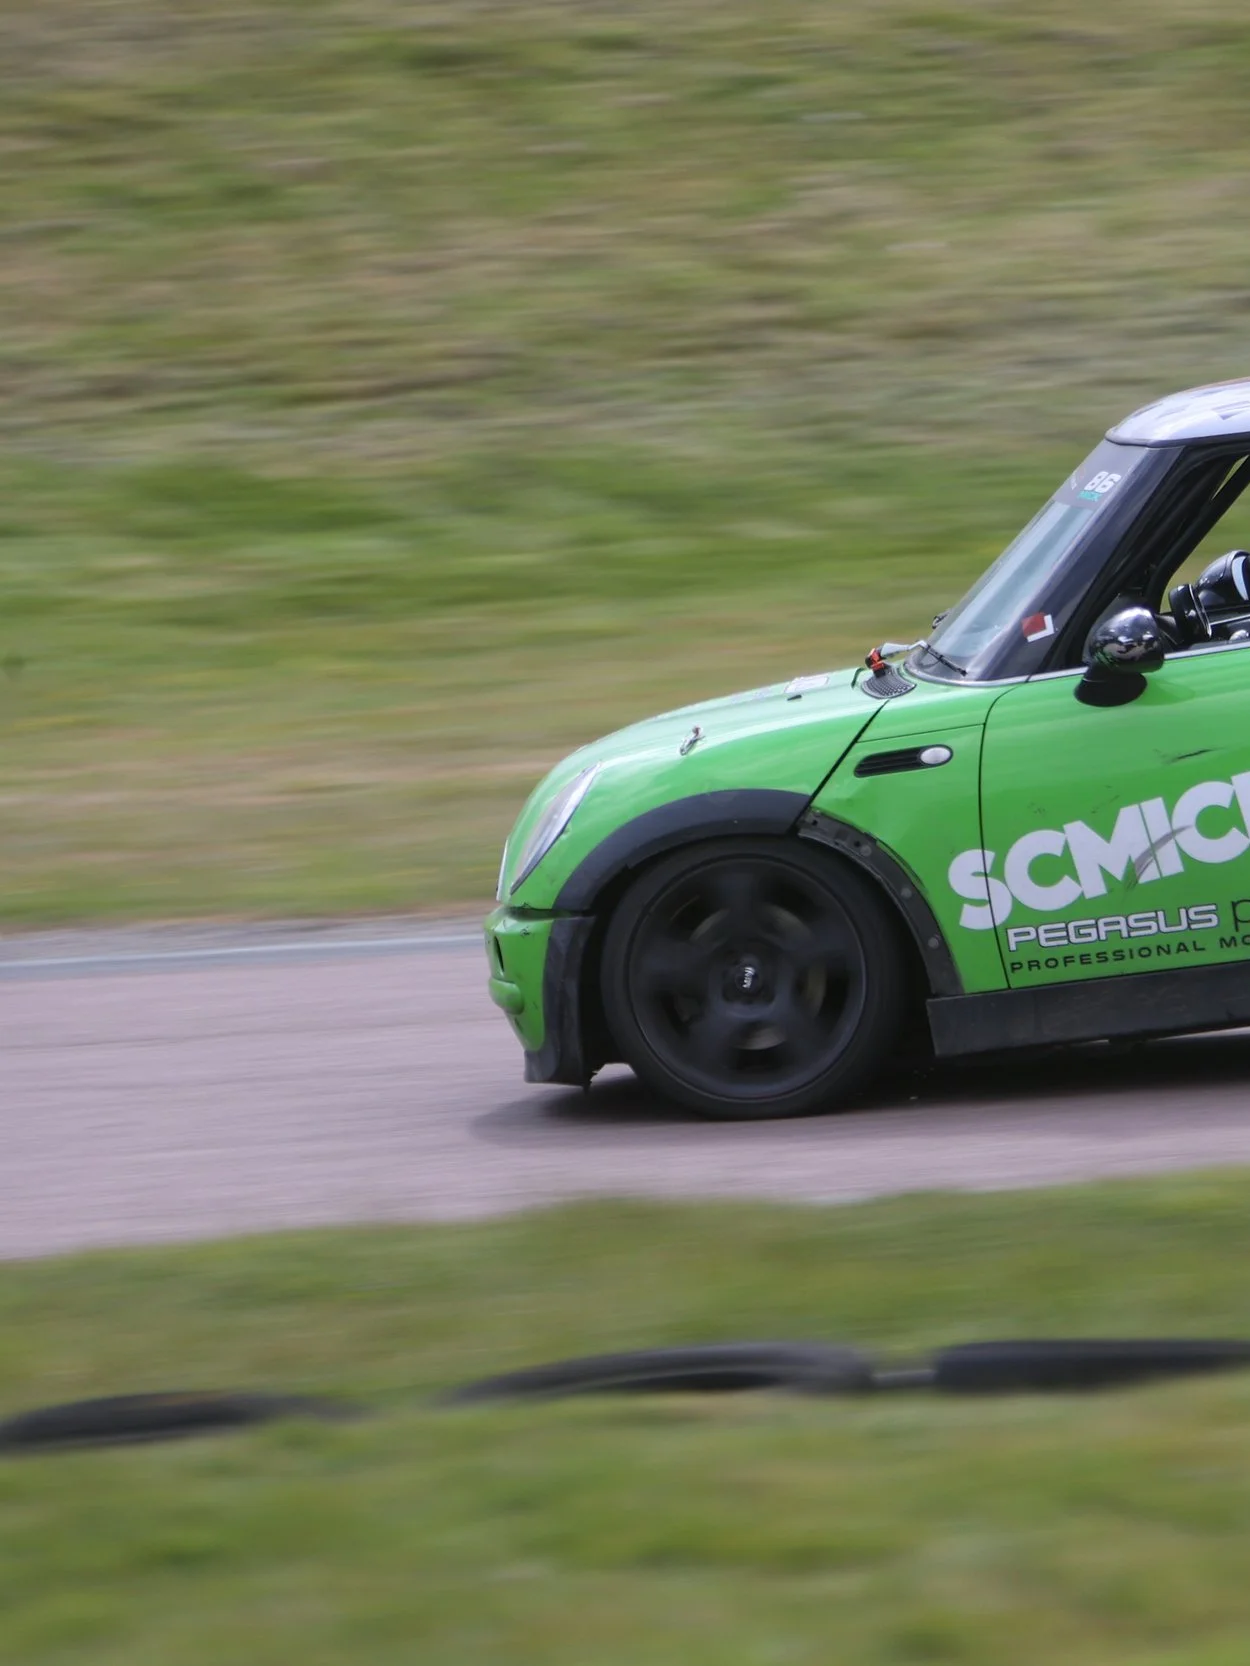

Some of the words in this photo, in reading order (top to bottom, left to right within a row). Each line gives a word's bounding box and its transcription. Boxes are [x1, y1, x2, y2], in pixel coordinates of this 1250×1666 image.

[1083, 471, 1121, 494] 86
[1006, 904, 1219, 951] PEGASUS
[1010, 941, 1206, 973] PROFESSIONAL
